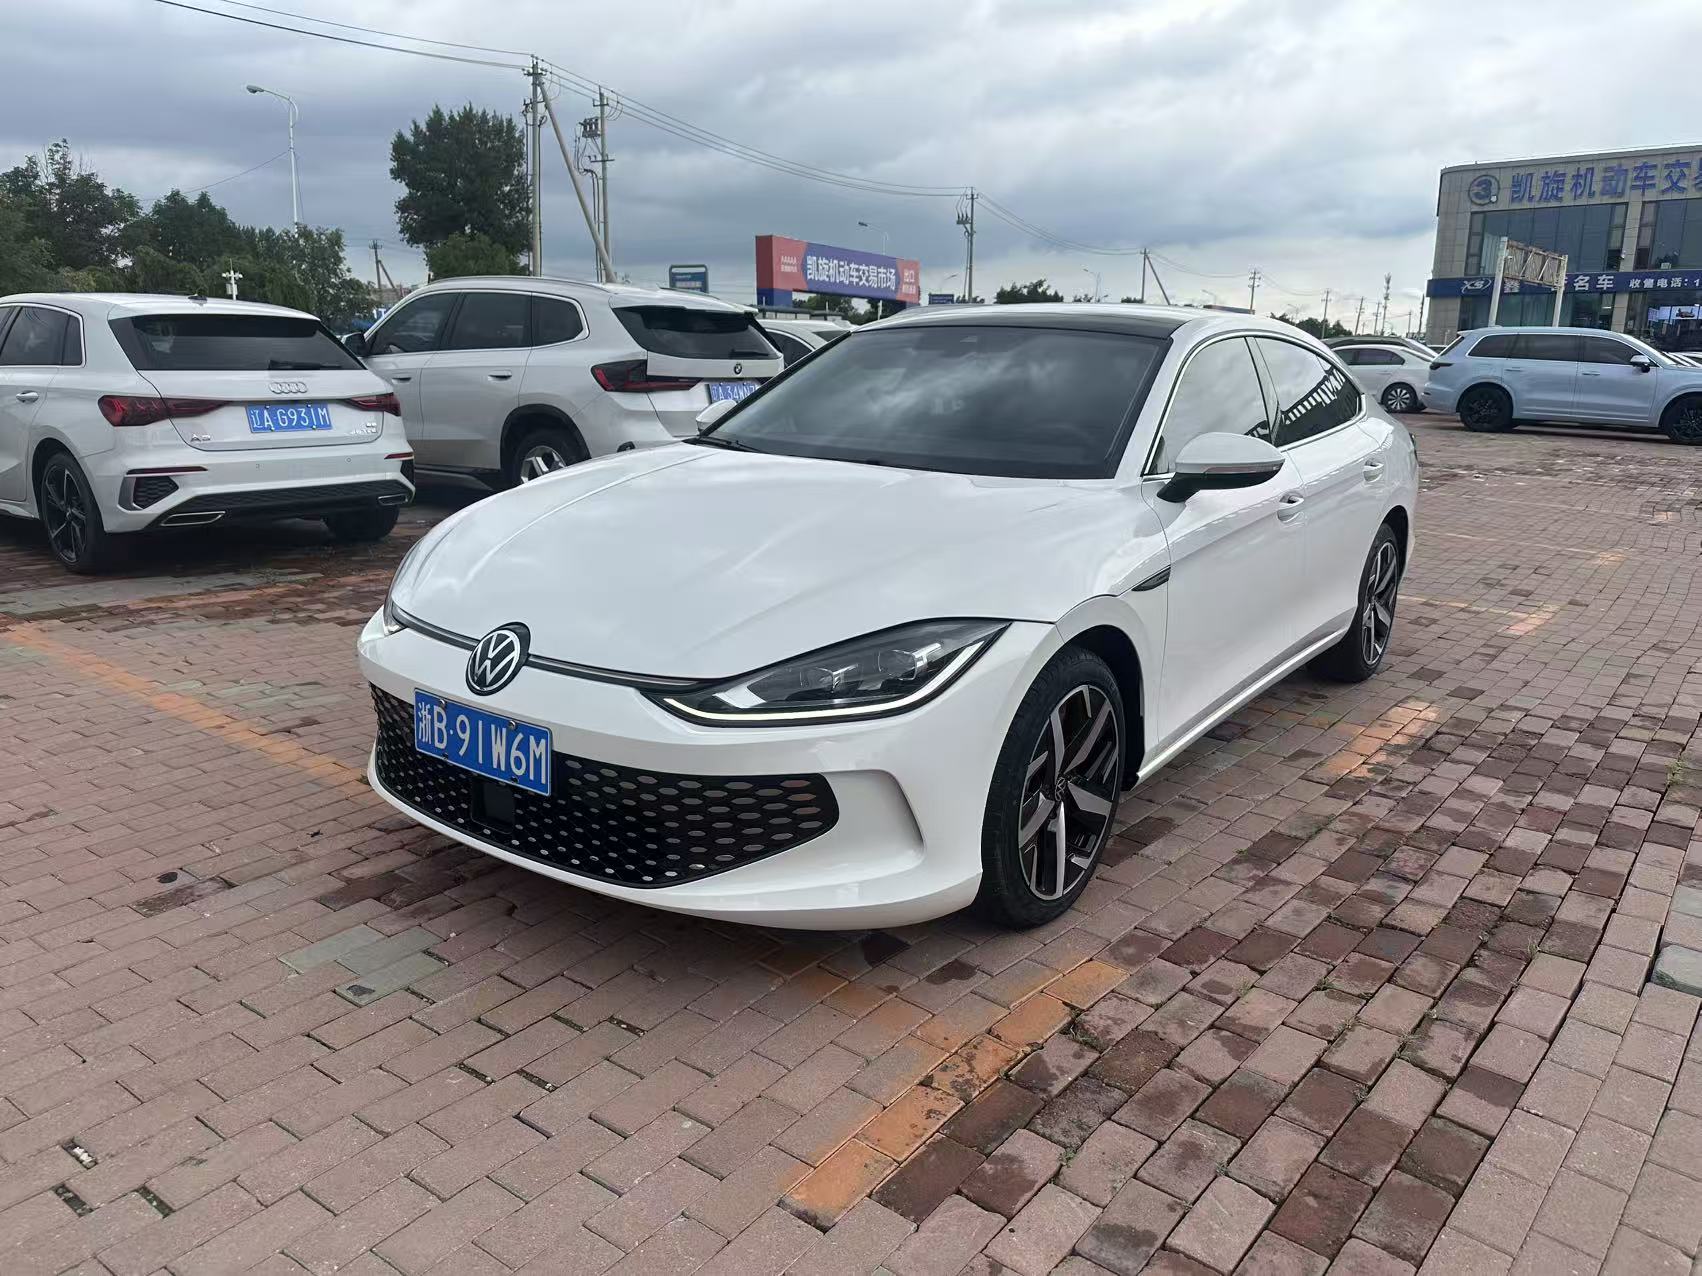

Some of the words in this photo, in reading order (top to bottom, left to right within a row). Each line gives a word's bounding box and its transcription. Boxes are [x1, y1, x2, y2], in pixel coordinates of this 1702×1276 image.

[1510, 157, 1702, 203] 凯旋机动车交
[806, 255, 896, 290] 凯旋机动车交易市场
